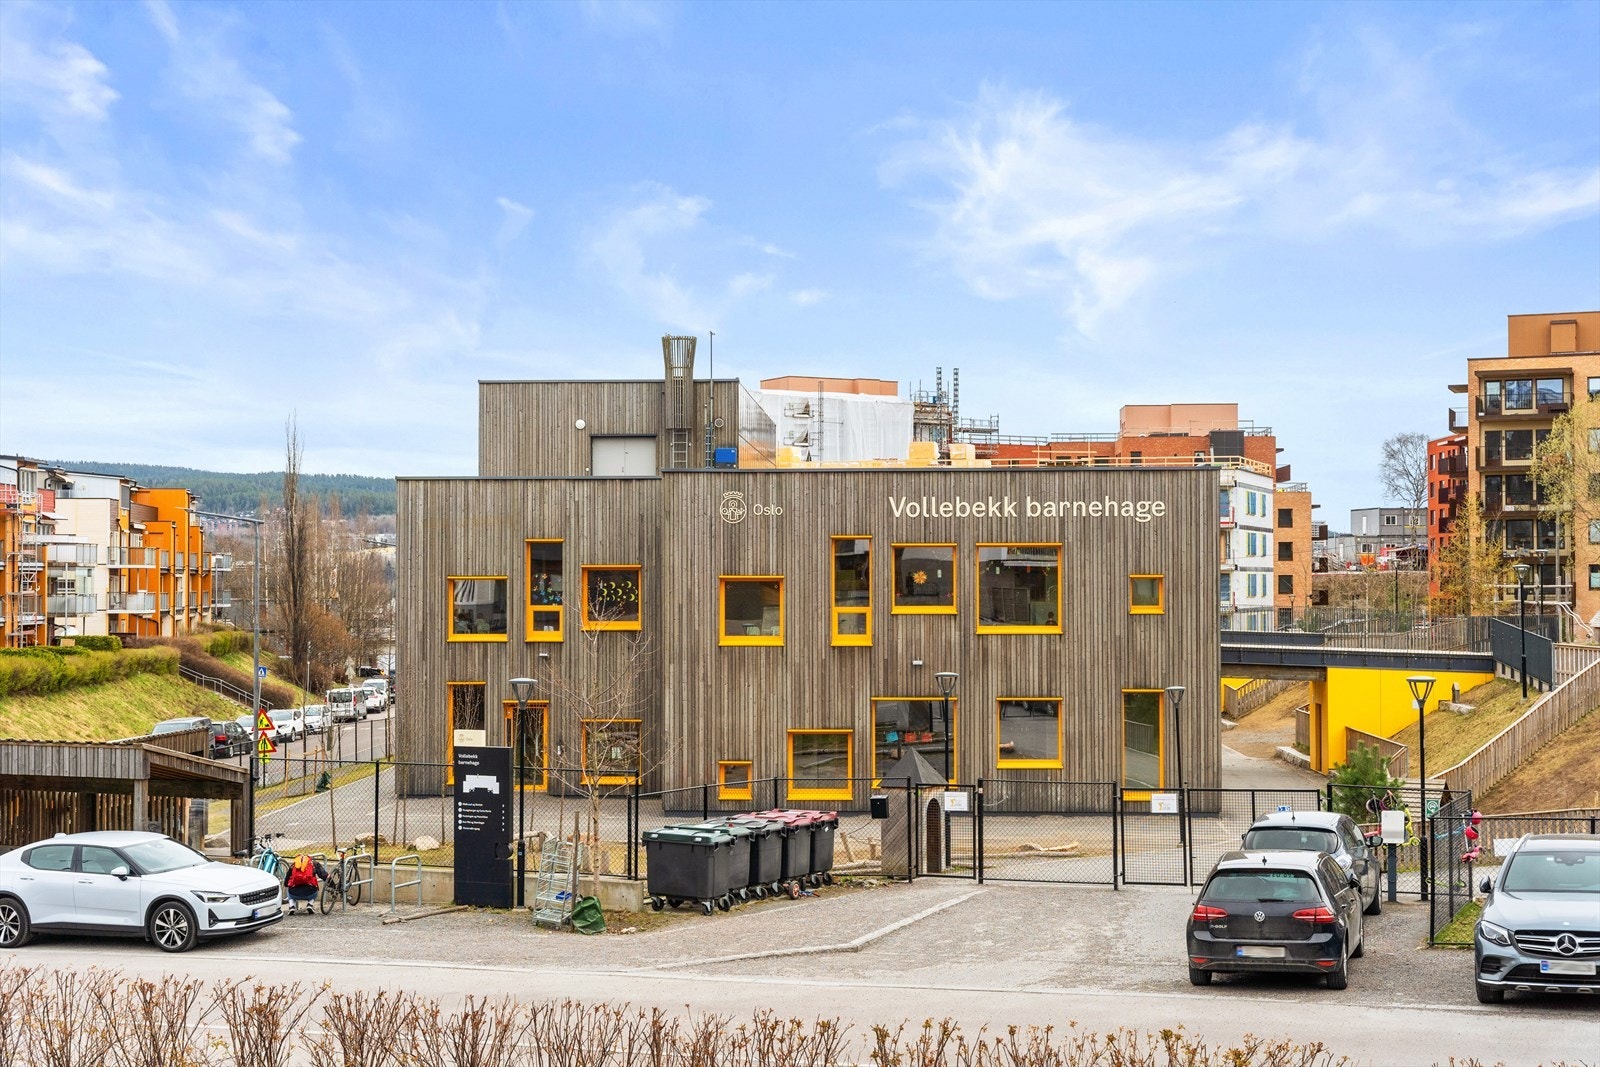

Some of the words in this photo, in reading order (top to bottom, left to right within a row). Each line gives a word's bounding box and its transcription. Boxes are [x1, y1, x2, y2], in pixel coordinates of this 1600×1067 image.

[753, 503, 783, 516] Oslo
[889, 496, 1017, 518] Vollebekk
[1026, 496, 1166, 522] barnehage
